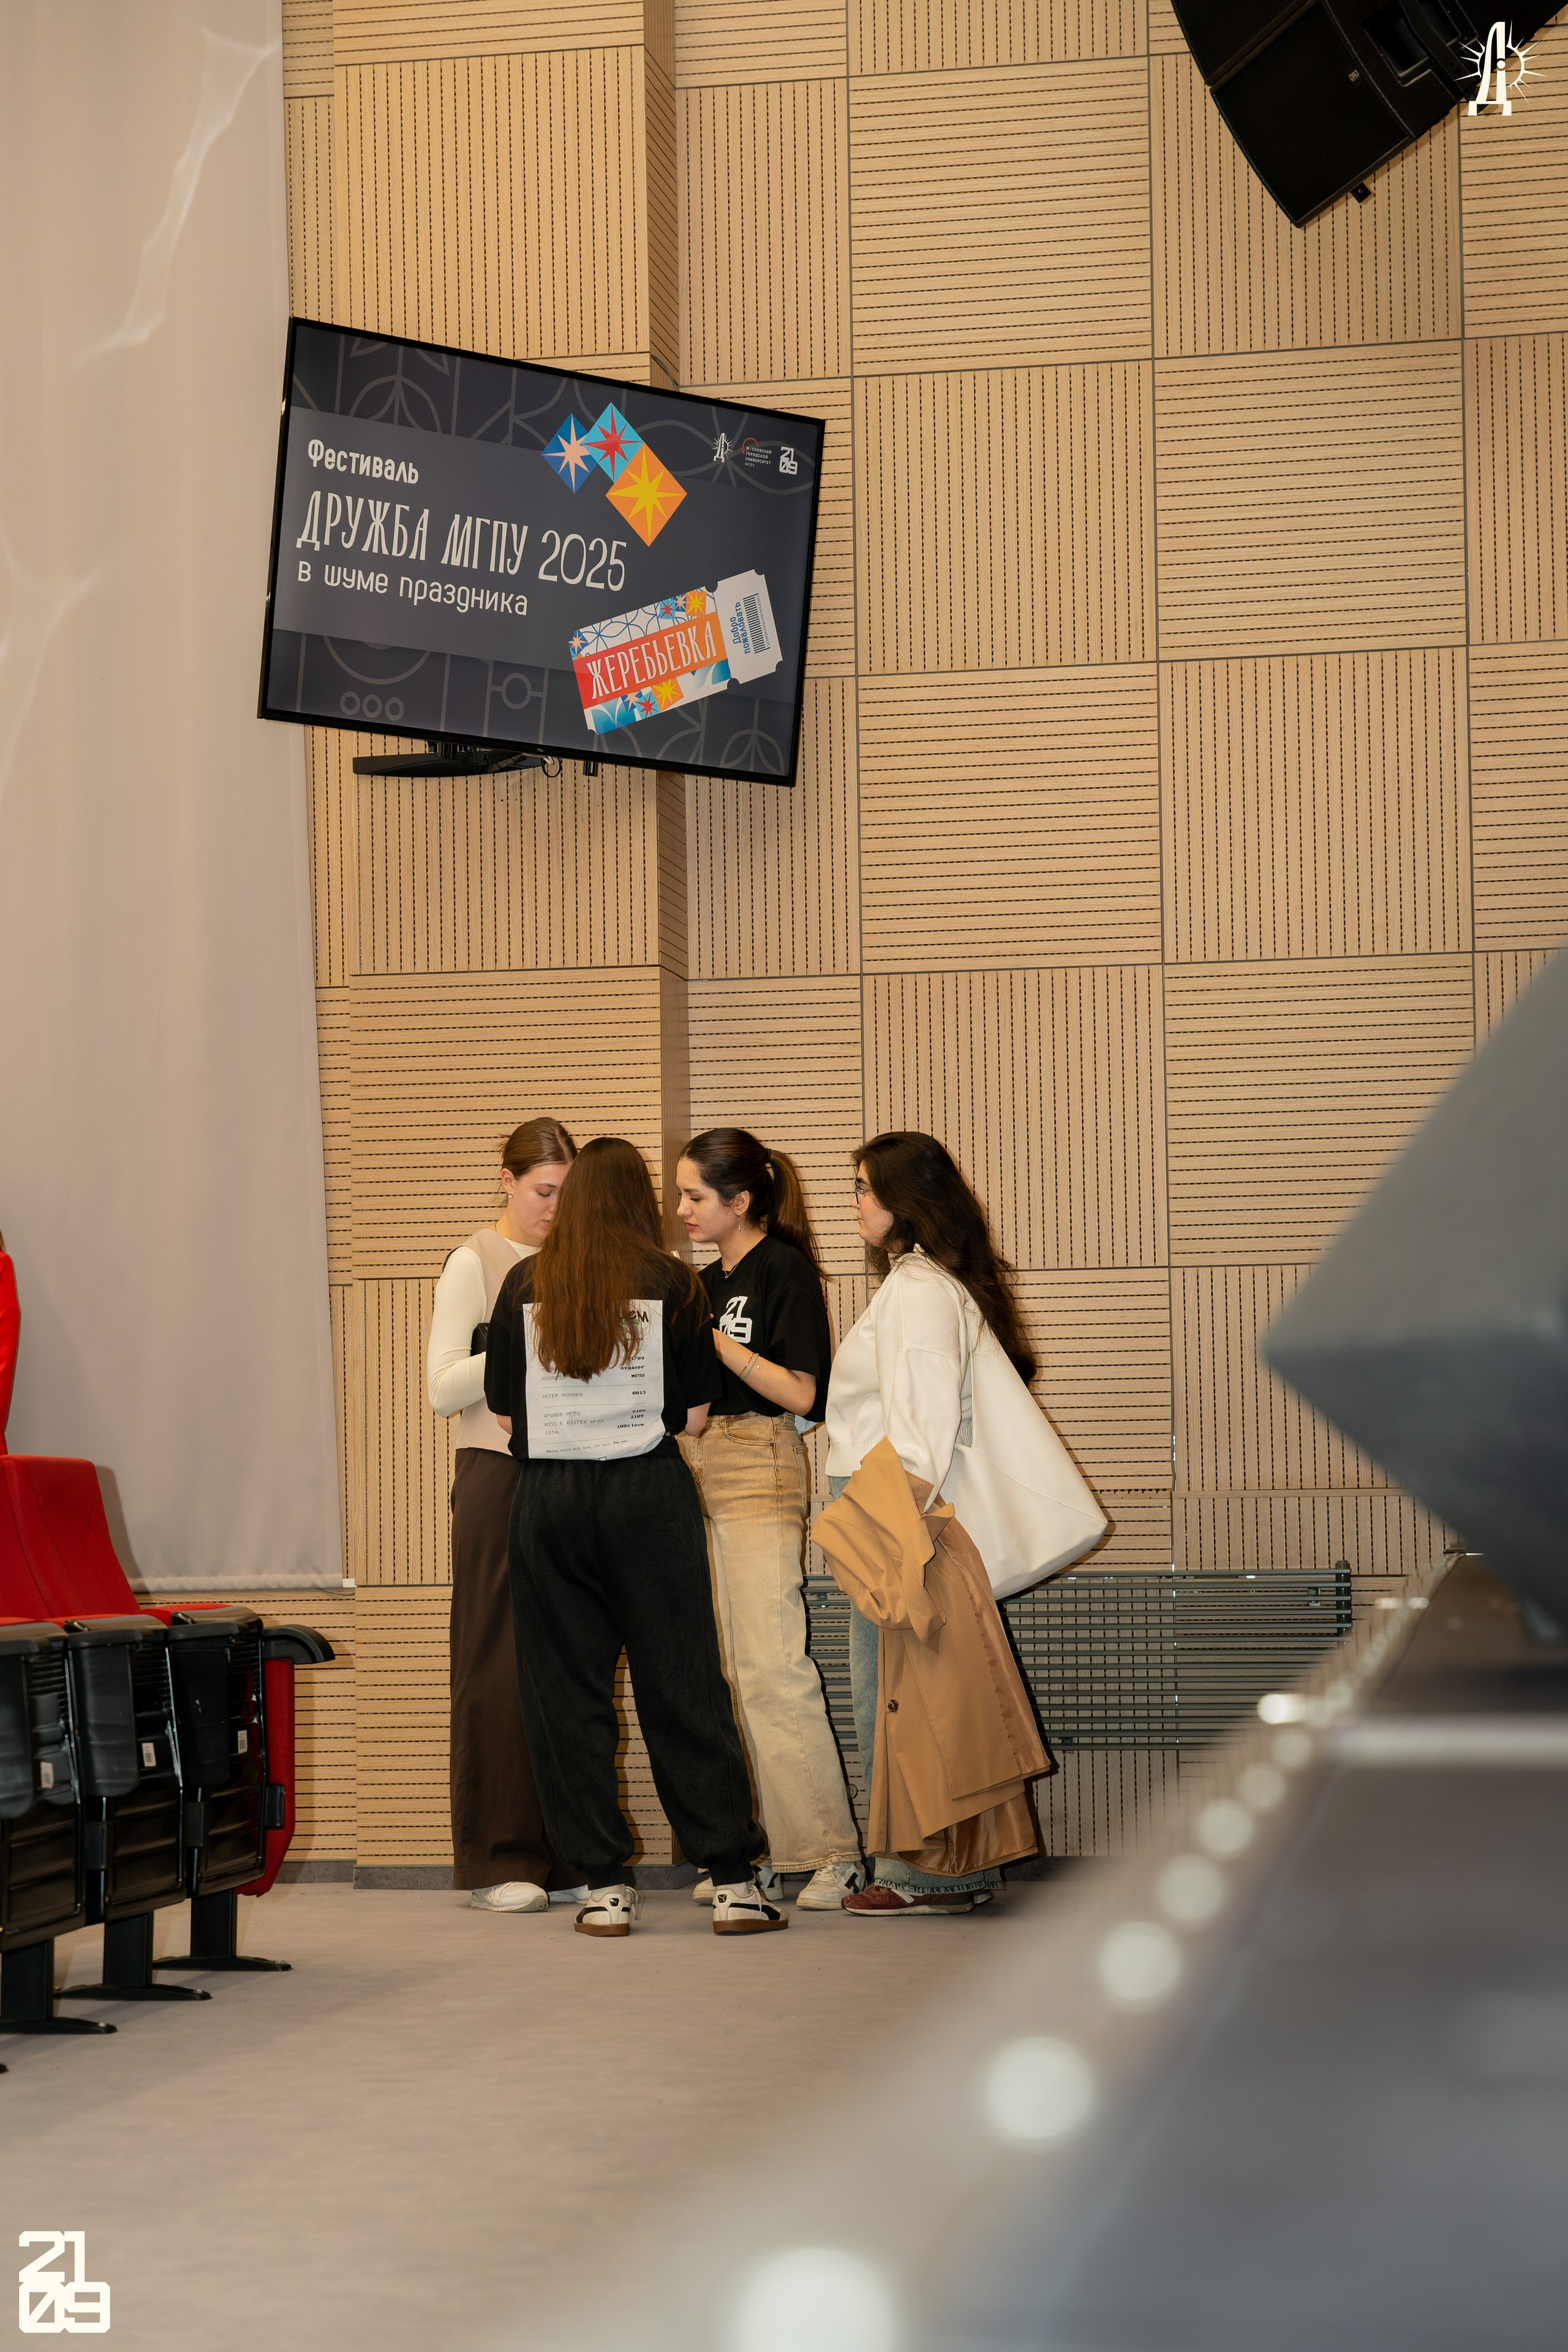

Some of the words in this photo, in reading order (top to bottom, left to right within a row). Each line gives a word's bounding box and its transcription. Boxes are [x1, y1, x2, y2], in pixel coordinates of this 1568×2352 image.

[307, 439, 419, 484] Фестиваль
[780, 446, 794, 461] 21
[296, 491, 429, 560] ДРУЖБА
[440, 513, 528, 575] МГПУ
[538, 530, 627, 591] 2025
[298, 560, 311, 582] в
[324, 564, 388, 594] шуме
[399, 576, 529, 616] праздника
[730, 616, 742, 644] Добро
[735, 602, 751, 654] пожаловать
[586, 620, 717, 700] ЖЕРЕБЬЕВКА
